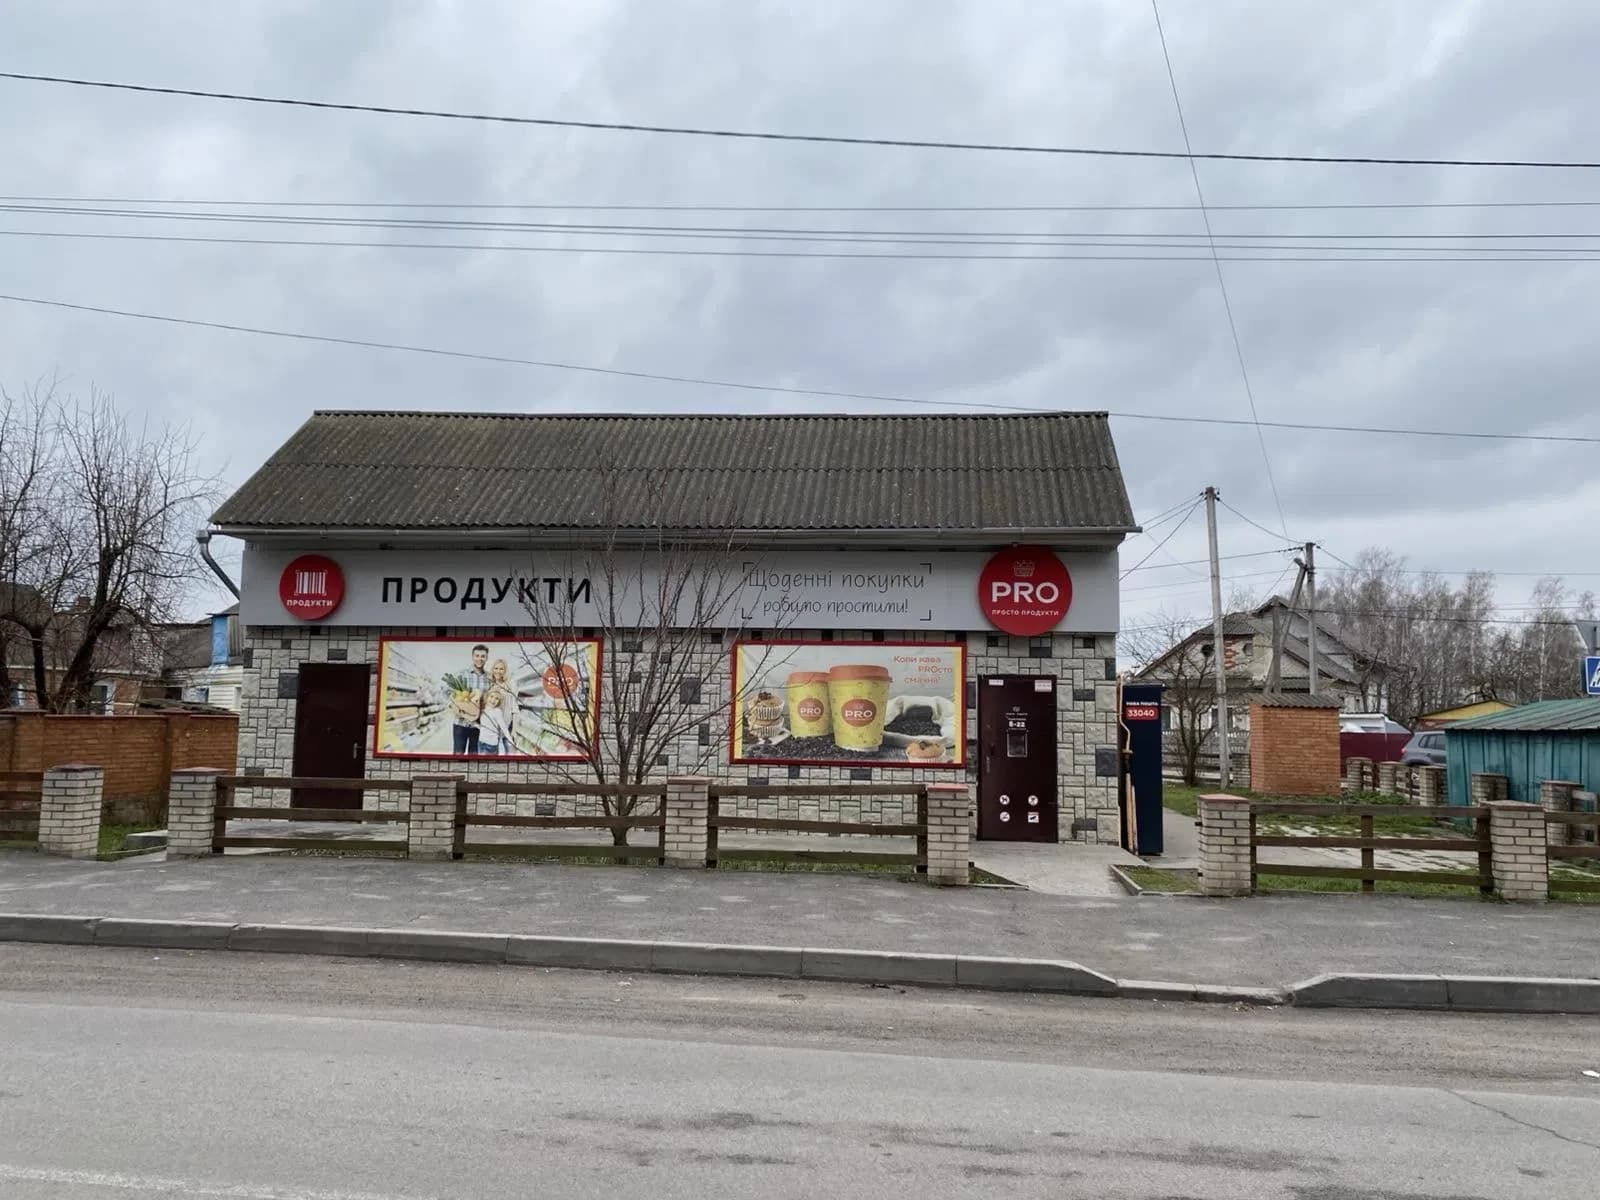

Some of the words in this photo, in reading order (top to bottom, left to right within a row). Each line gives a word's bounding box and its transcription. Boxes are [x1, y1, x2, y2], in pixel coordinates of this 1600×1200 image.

[748, 570, 832, 592] Щоденні
[842, 573, 924, 593] покупки
[381, 576, 592, 610] ПРОДУКТИ
[991, 581, 1059, 604] PRO
[286, 599, 333, 607] ПРОДУКТИ
[763, 596, 821, 616] робимо
[827, 598, 908, 617] простими!
[1021, 609, 1059, 617] ПРОДУКТИ
[800, 707, 822, 715] PRO
[844, 709, 873, 718] PRO
[1127, 709, 1155, 717] 33040
